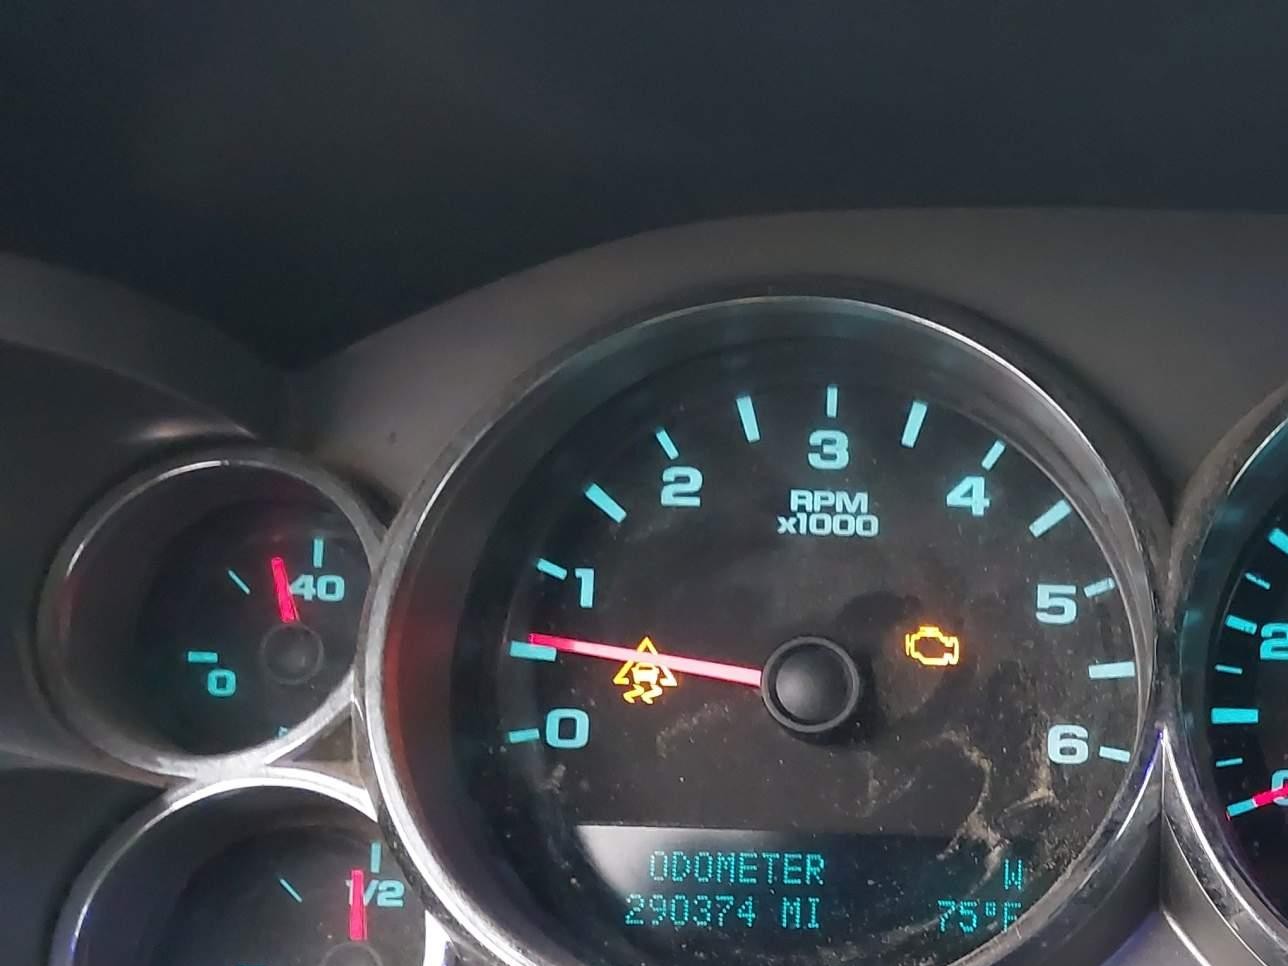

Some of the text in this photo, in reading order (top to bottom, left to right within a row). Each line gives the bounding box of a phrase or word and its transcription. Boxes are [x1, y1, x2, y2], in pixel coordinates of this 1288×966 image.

[808, 430, 849, 470] 3
[661, 467, 703, 507] 2
[790, 489, 869, 514] RPM
[947, 477, 989, 516] 4
[778, 513, 878, 537] x1000
[289, 575, 345, 602] 40
[575, 568, 595, 608] 1
[1036, 585, 1077, 624] 5
[208, 669, 236, 697] 0
[546, 709, 590, 749] 0
[1047, 725, 1089, 764] 6
[648, 850, 825, 886] ODOMETER
[1004, 859, 1022, 890] W
[625, 893, 820, 930] 290374 MI
